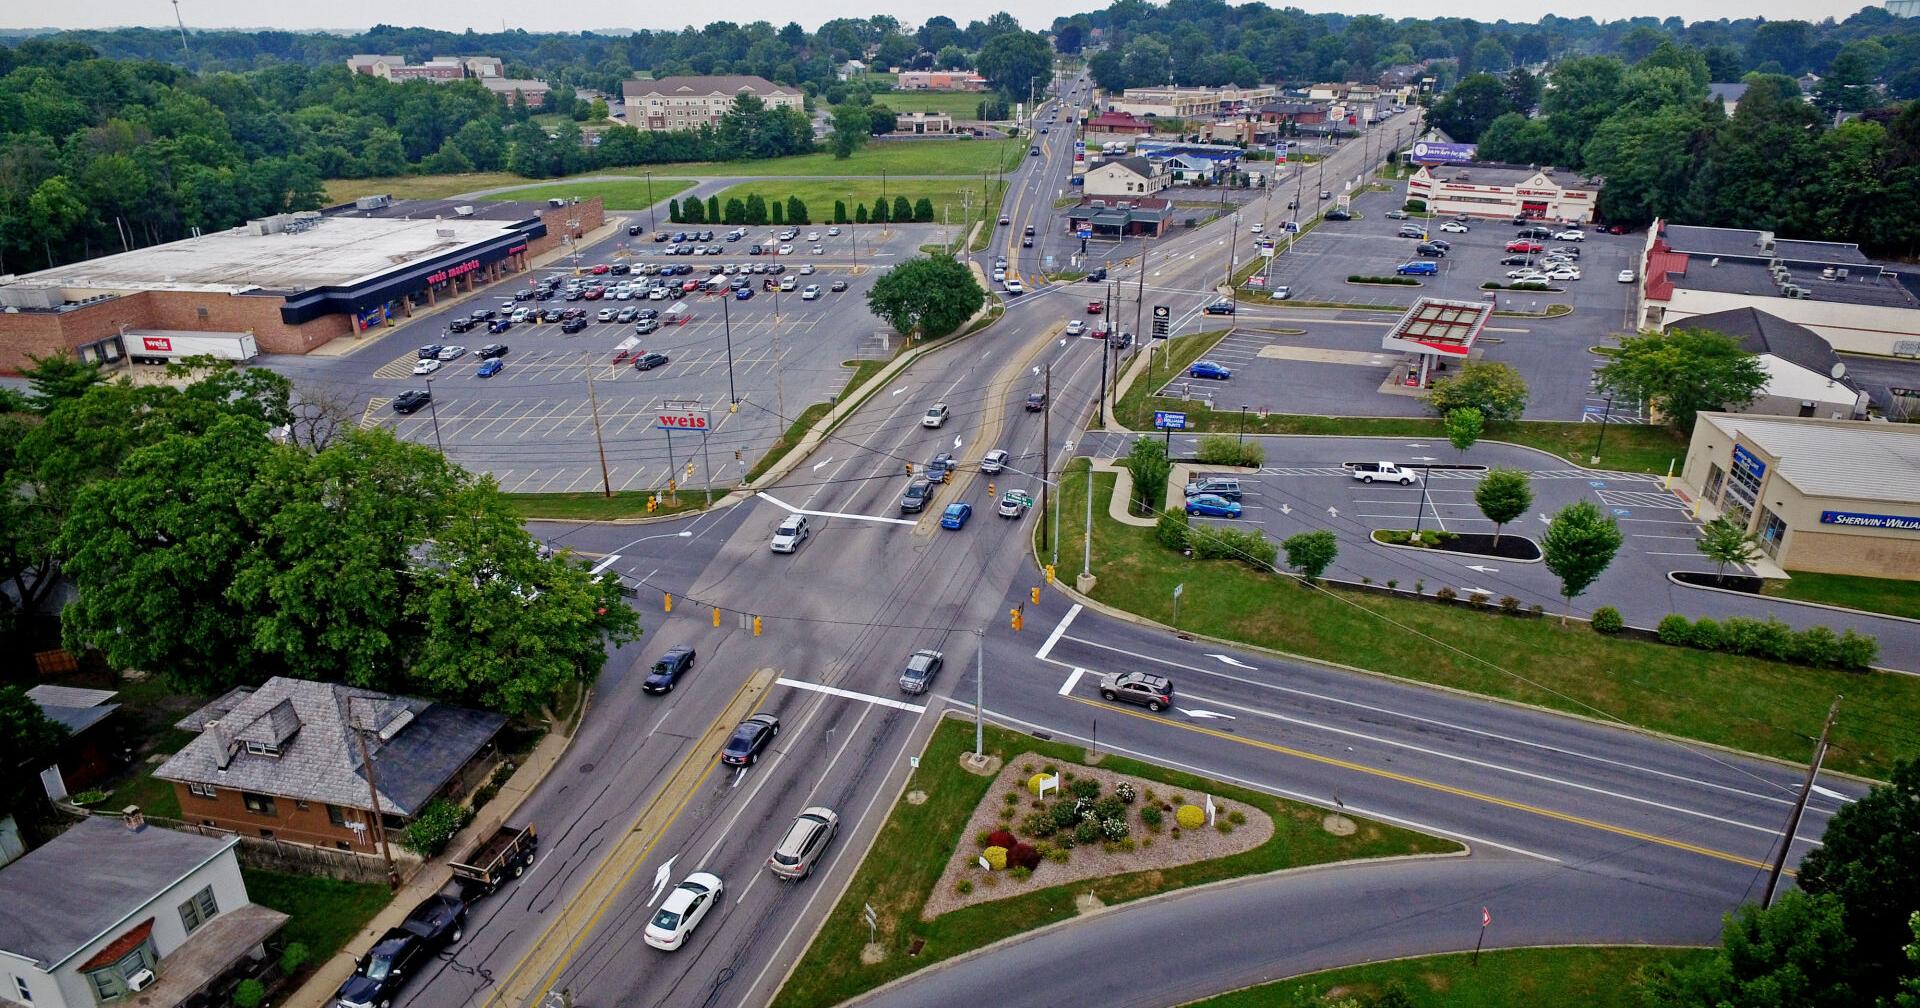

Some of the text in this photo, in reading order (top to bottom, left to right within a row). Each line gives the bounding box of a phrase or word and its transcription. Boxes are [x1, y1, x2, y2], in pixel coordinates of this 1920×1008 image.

[427, 260, 480, 284] weis markets
[145, 339, 168, 347] weis
[659, 413, 706, 428] weis
[1834, 514, 1920, 530] SHERWIN-WILLIA
